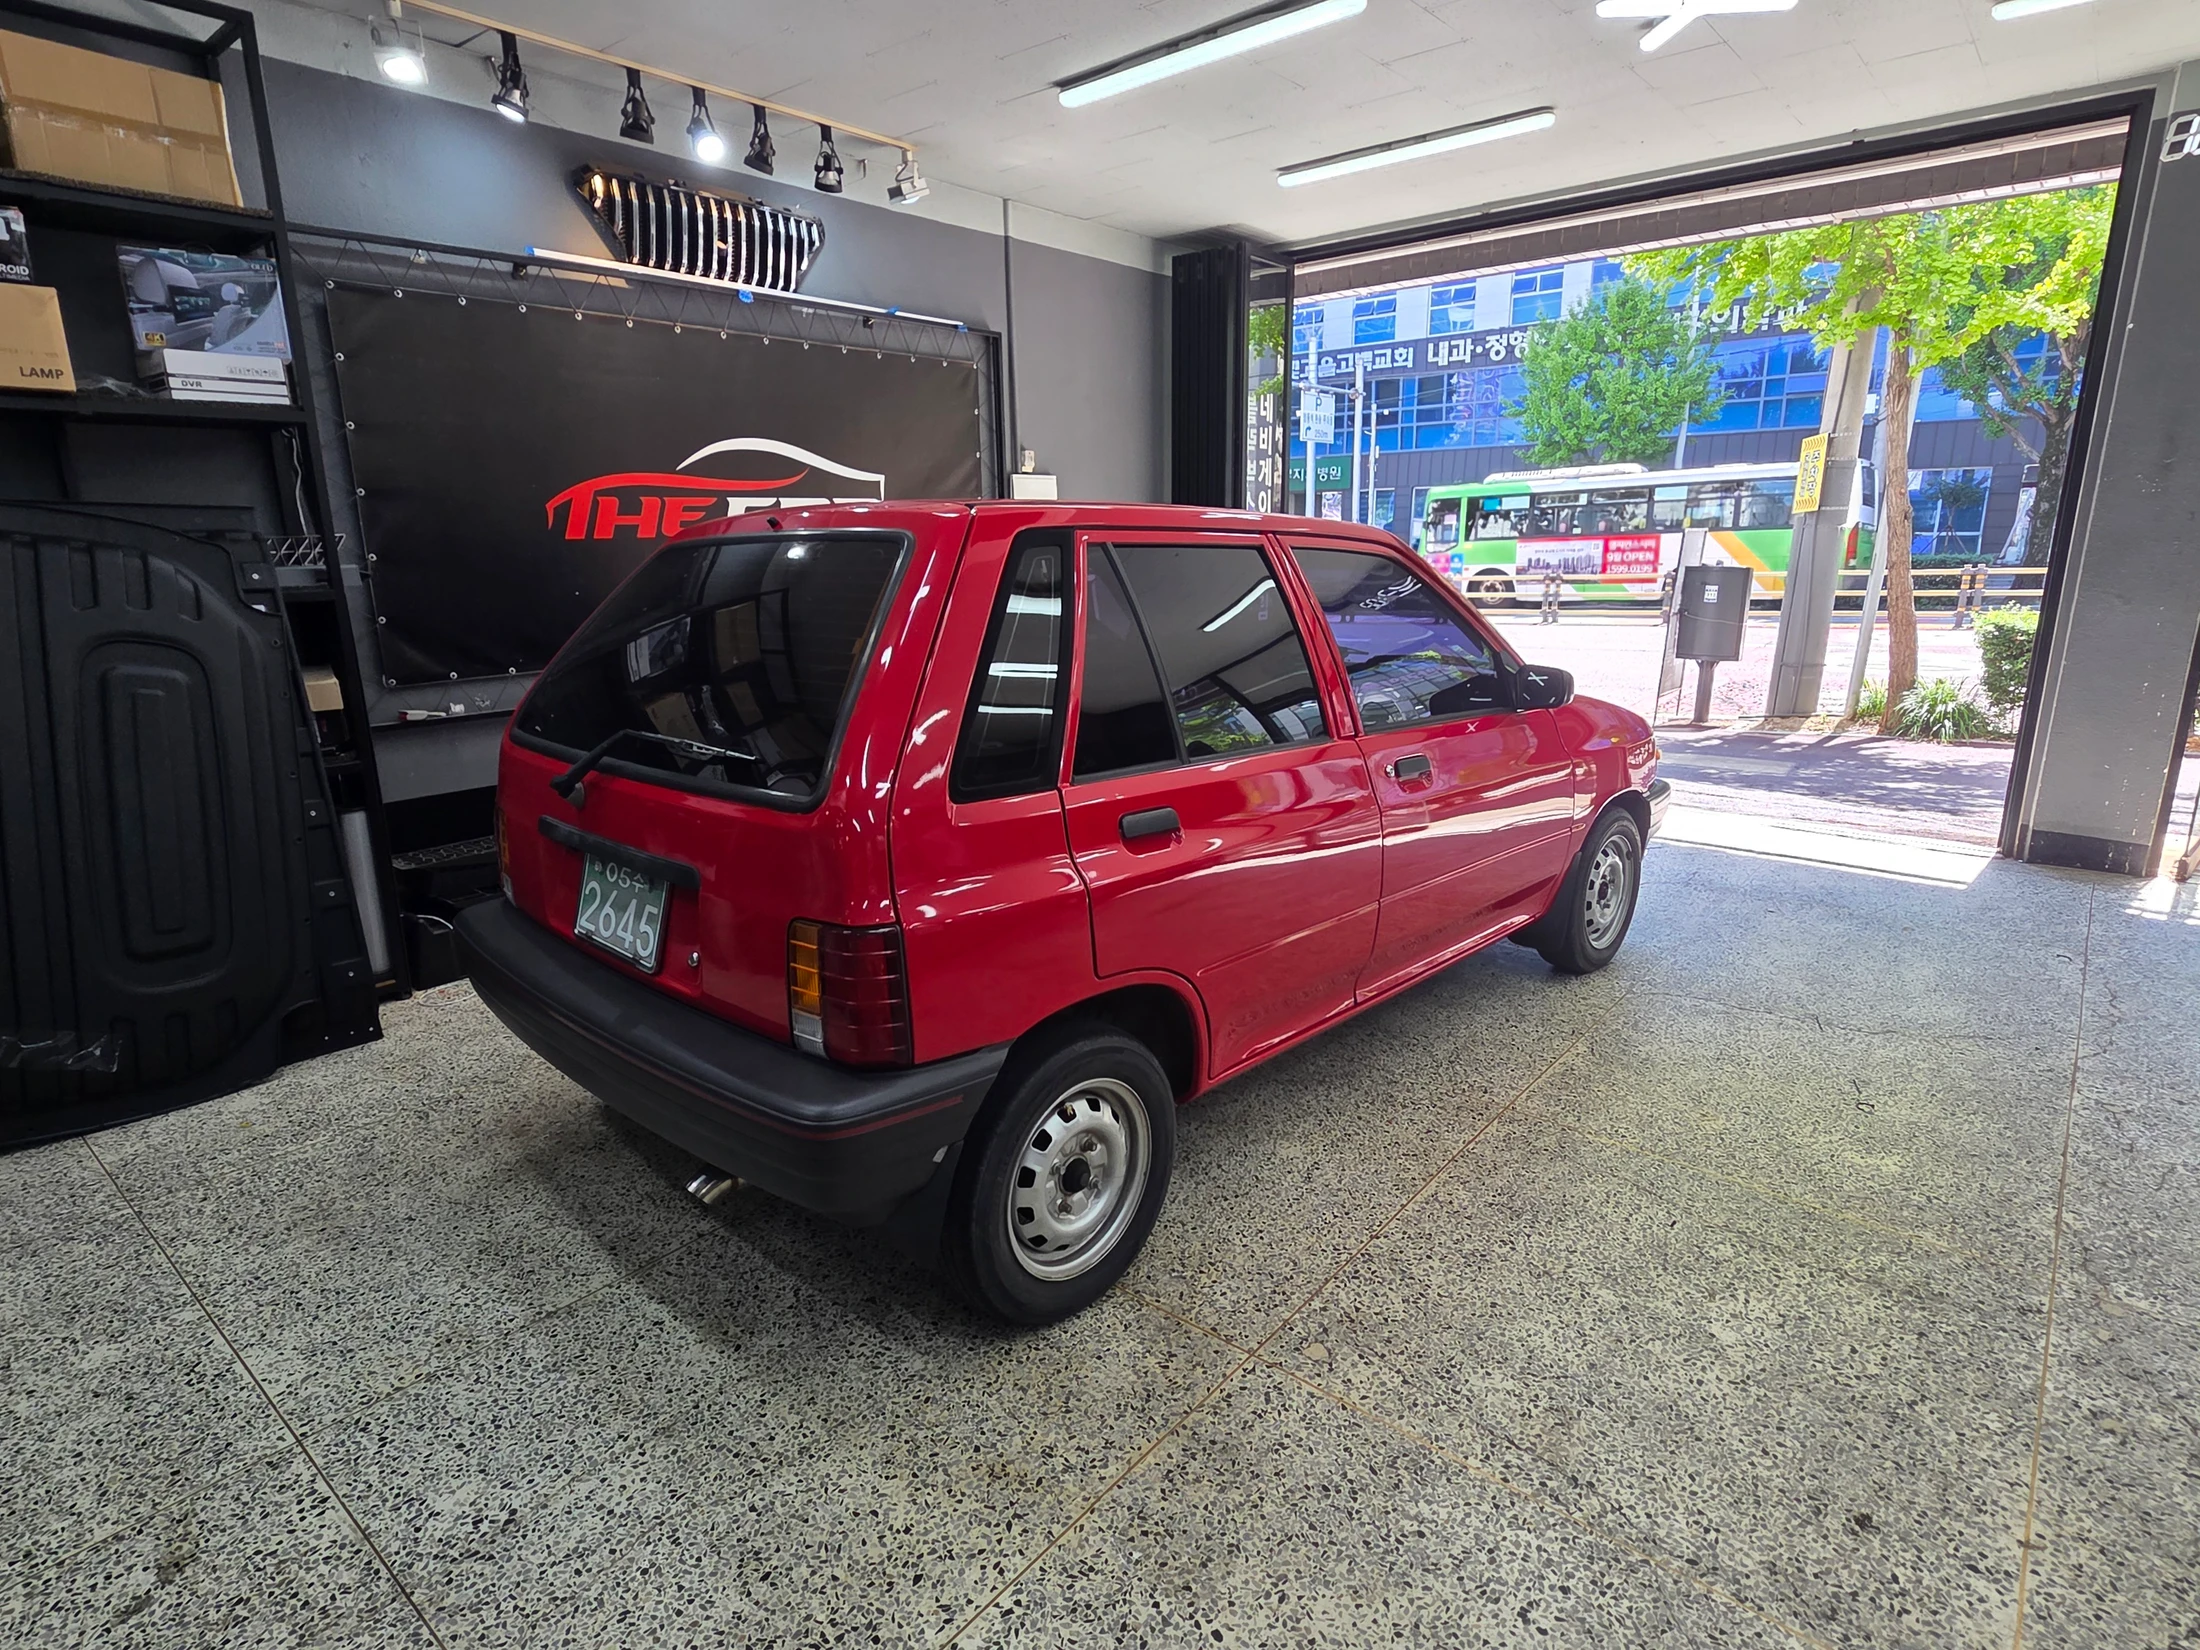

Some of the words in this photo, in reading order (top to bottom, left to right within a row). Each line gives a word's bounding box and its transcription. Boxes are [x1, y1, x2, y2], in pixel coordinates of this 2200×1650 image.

[19, 366, 64, 380] LAMP
[181, 379, 203, 389] DVR
[546, 473, 720, 540] THE
[1623, 550, 1654, 562] OPEN
[1605, 563, 1654, 574] 1599.0199
[579, 880, 659, 958] 2645
